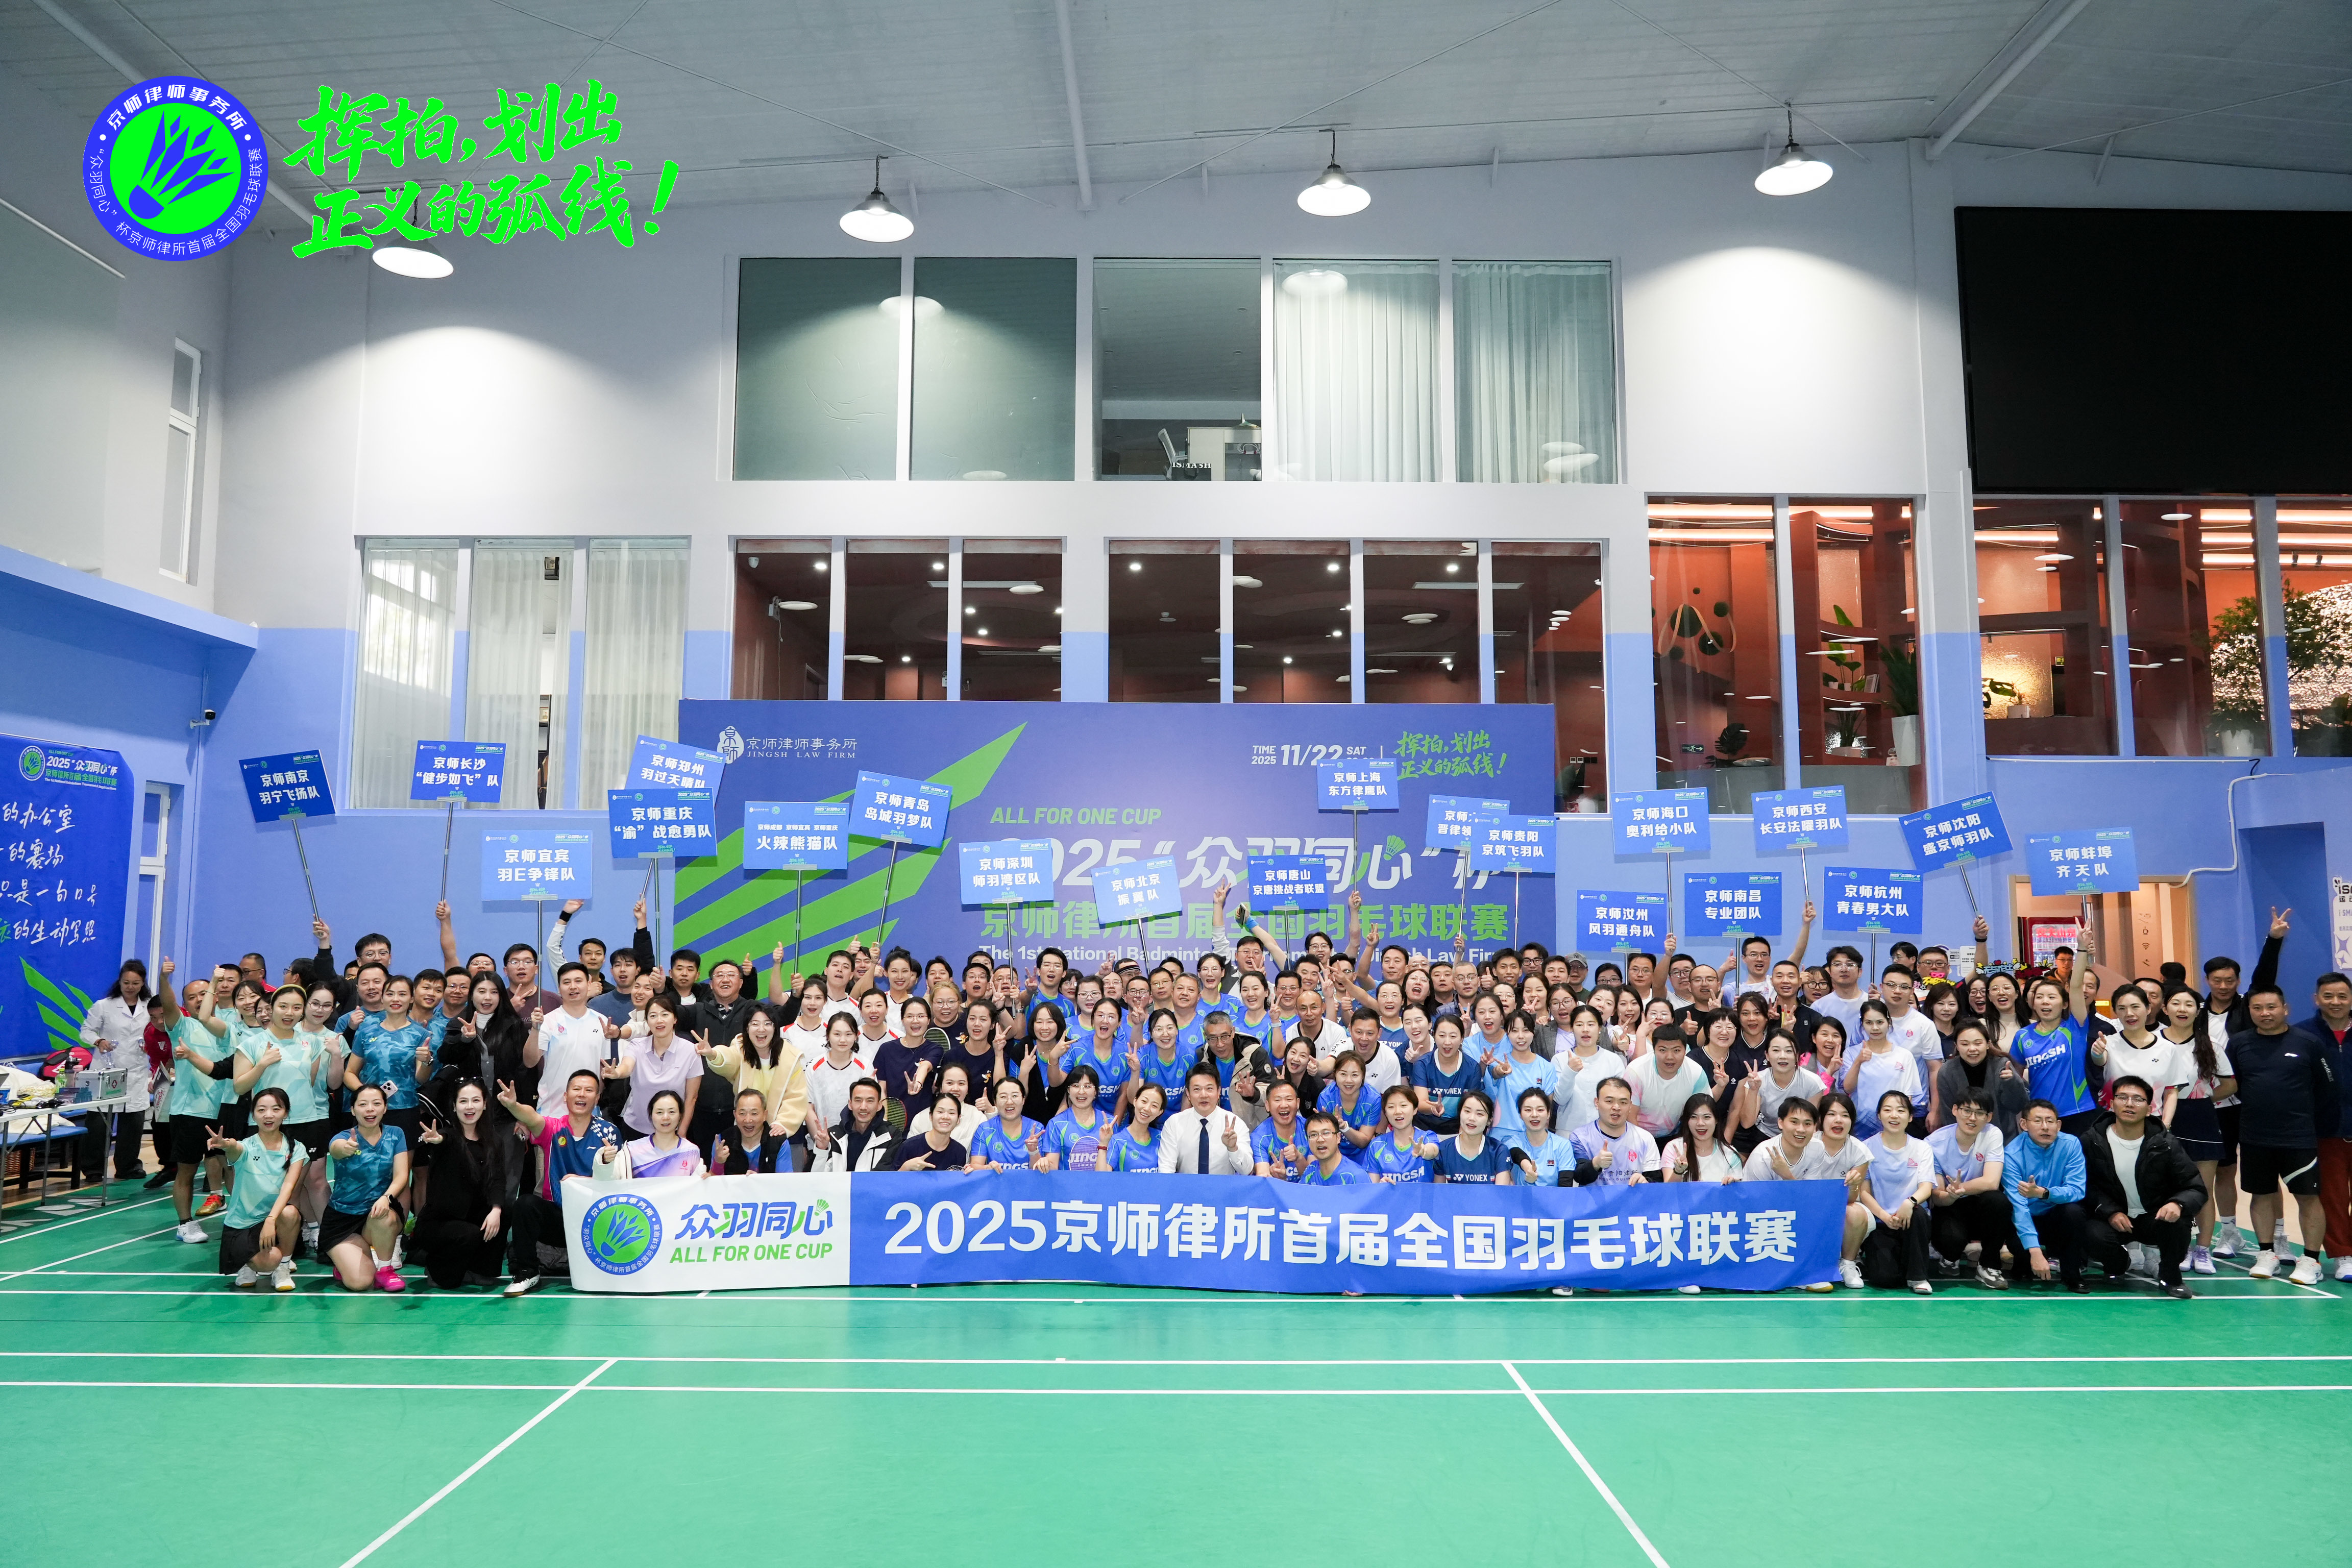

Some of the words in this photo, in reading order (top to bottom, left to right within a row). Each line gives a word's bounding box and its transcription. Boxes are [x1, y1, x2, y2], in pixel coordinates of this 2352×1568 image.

[746, 737, 857, 750] 京师律师事务所
[433, 756, 486, 770] 京师长沙
[1252, 755, 1276, 765] 2025
[1253, 745, 1276, 754] TIME
[1281, 744, 1343, 766] 11/22
[1346, 746, 1367, 755] SAT
[651, 754, 704, 776] 京师郑州
[260, 770, 310, 787] 京师南京
[641, 767, 706, 788] 羽过天晴队
[1334, 772, 1381, 782] 京师上海
[259, 786, 320, 804] 羽宁飞扬队
[1329, 785, 1387, 796] 东方律鹰队
[874, 792, 929, 812] 京师青岛
[3, 801, 75, 833] 的办公室
[631, 806, 693, 821] 京师重庆
[865, 807, 932, 830] 岛城羽梦队
[990, 807, 1030, 824] ALL
[1034, 808, 1073, 824] FOR
[1077, 808, 1123, 825] ONE
[1126, 808, 1162, 825] CUP
[1632, 806, 1688, 821] 京师海口
[1772, 803, 1827, 818] 京师西安
[1438, 823, 1472, 837] 晋律领
[1627, 822, 1697, 838] 奥利给小队
[1760, 817, 1842, 835] 长安法曜羽队
[1923, 813, 1981, 839] 京师沈阳
[756, 836, 838, 851] 火辣熊猫队
[1488, 829, 1538, 842] 京师贵阳
[1922, 827, 1994, 856] 盛京师羽队
[0, 839, 63, 870] 的赛场
[504, 849, 569, 863] 京师宜宾
[1482, 844, 1544, 857] 京筑飞羽队
[2049, 845, 2113, 862] 京师蚌埠
[979, 856, 1033, 871] 京师深圳
[2056, 863, 2109, 878] 齐天队
[497, 867, 575, 881] 羽E争锋队
[973, 872, 1041, 888] 师羽湾区队
[1264, 869, 1311, 881] 京师唐山
[1111, 873, 1161, 892] 京师北京
[1253, 884, 1325, 895] 京唐挑战者联盟
[1117, 889, 1159, 906] 振翼队
[1705, 889, 1761, 903] 京师南昌
[1844, 884, 1902, 900] 京师杭州
[1595, 907, 1648, 921] 京师汝州
[1704, 906, 1761, 920] 专业团队
[1836, 901, 1909, 917] 青春男大队
[1588, 923, 1655, 937] 风羽通舟队
[979, 945, 1013, 960] The
[1055, 946, 1122, 961] ational
[1127, 946, 1213, 961] Badmint
[1469, 948, 1498, 963] Fir
[1069, 1153, 1098, 1163] JING
[1465, 1173, 1487, 1182] YONEX
[591, 1196, 654, 1217] 京师律师事务所
[675, 1198, 834, 1239] 众羽同心
[884, 1200, 1797, 1271] 2025京师律所首届全国羽毛球联赛
[669, 1247, 708, 1263] ALL
[713, 1245, 749, 1262] FOR
[754, 1244, 791, 1261] ONE
[796, 1243, 832, 1259] CUP
